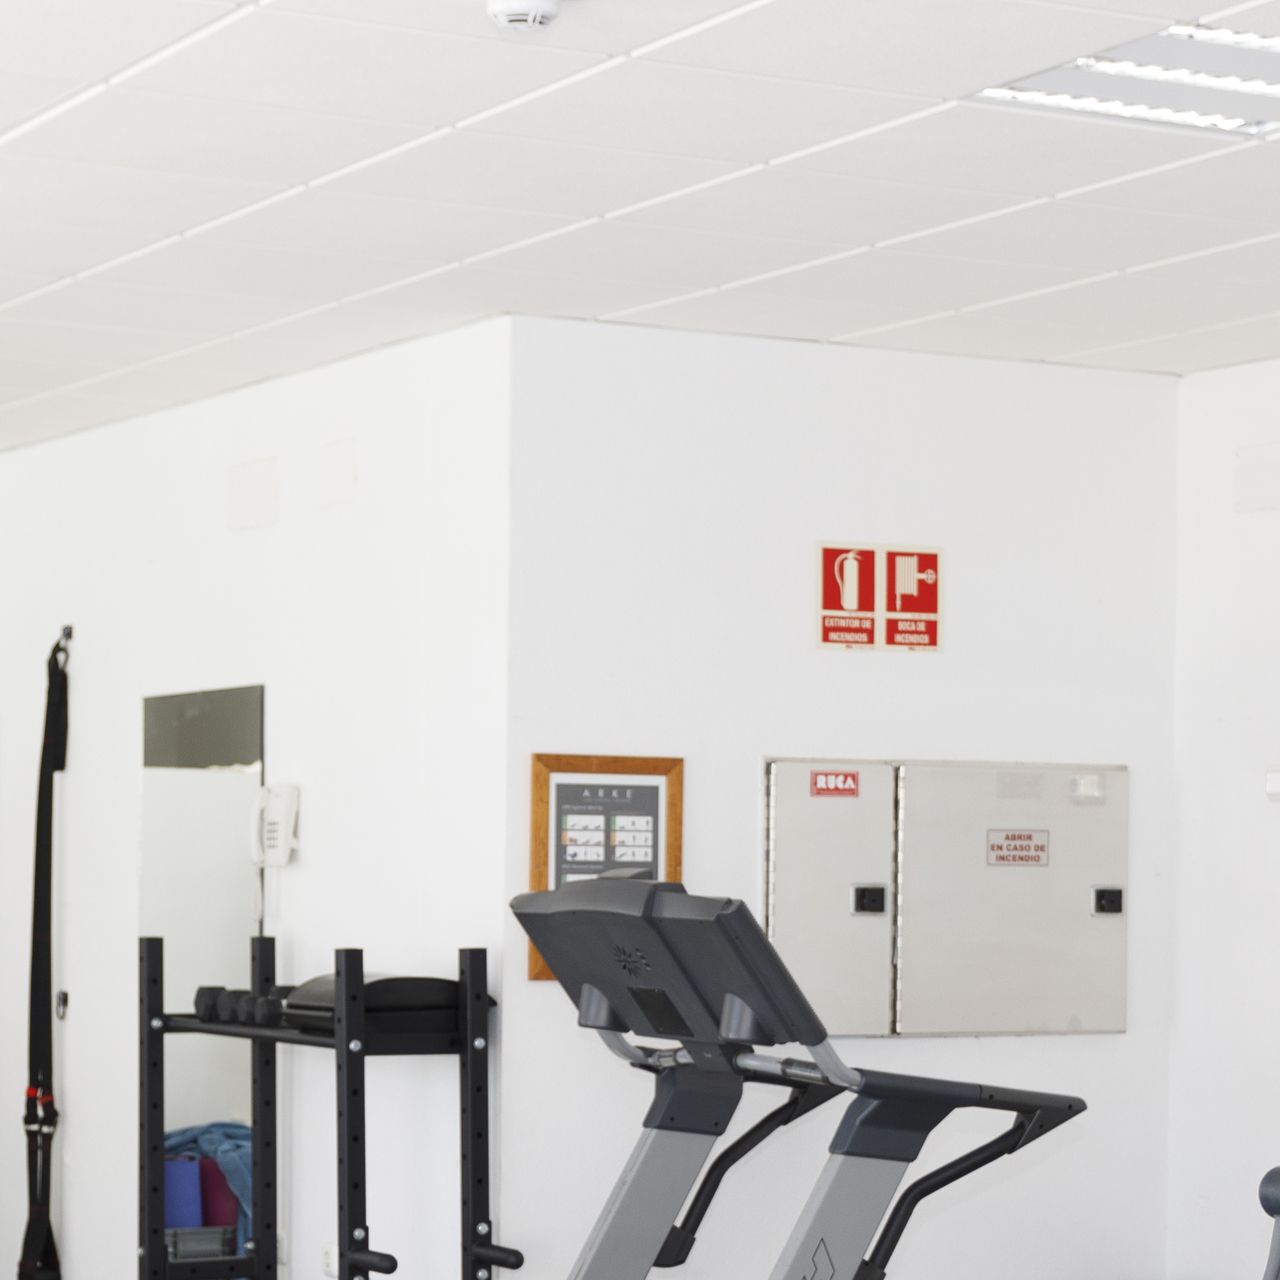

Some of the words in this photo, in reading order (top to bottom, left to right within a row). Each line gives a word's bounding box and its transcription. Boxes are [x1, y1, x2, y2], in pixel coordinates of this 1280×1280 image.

[1004, 833, 1033, 842] ABRIR
[991, 843, 1003, 852] EN
[1006, 843, 1031, 852] CASO
[1033, 843, 1046, 853] DE
[995, 853, 1041, 863] INCENDIO
